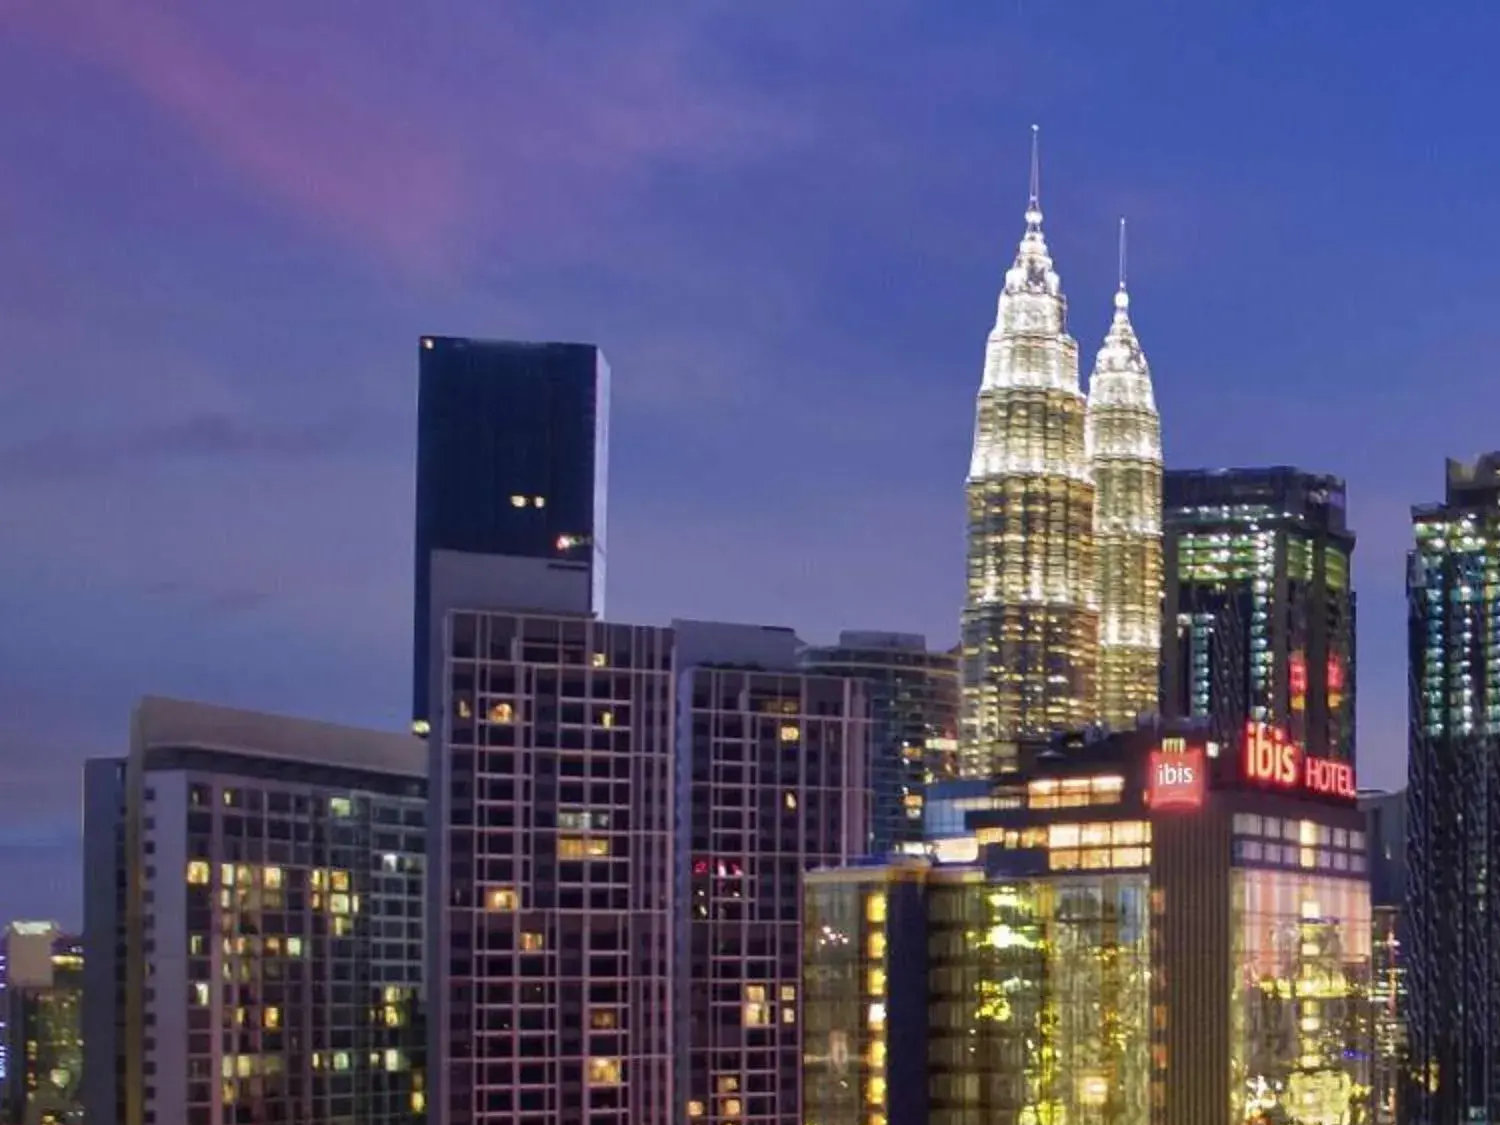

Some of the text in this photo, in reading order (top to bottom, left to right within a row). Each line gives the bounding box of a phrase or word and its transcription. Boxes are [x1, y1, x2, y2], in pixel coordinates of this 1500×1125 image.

[1158, 763, 1193, 786] ibis
[1247, 721, 1356, 798] ibis HOTEL
